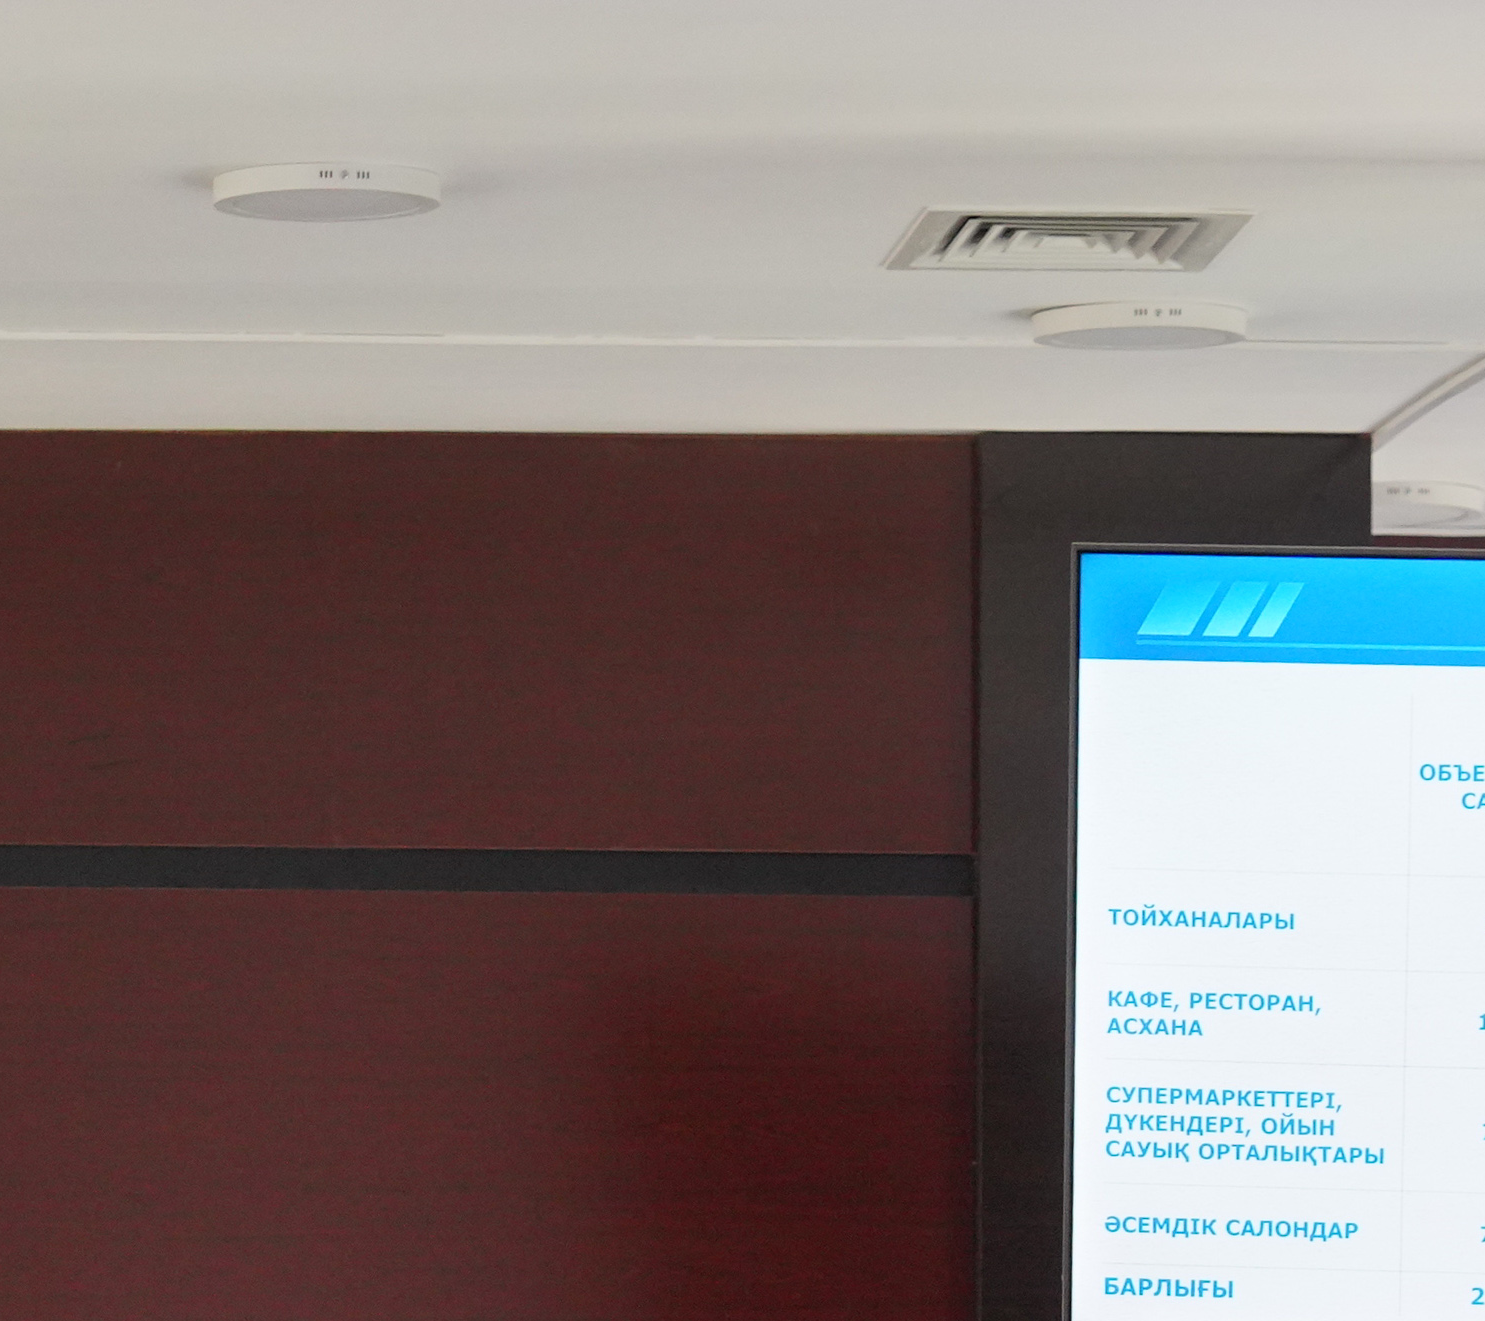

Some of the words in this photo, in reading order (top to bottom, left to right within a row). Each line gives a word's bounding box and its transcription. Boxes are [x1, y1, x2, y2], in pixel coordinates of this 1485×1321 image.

[1107, 904, 1295, 930] ТОЙХАНАЛАРЫ
[1108, 990, 1179, 1013] КАФЕ,
[1189, 992, 1321, 1016] РЕСТОРАН,
[1107, 1017, 1203, 1037] АСХАНА
[1105, 1086, 1344, 1115] СУПЕРМАРКЕТТЕРІ,
[1104, 1112, 1251, 1138] ДҮКЕНДЕРІ,
[1260, 1112, 1336, 1138] ОЙЫН
[1105, 1140, 1190, 1163] САУЫҚ
[1198, 1142, 1385, 1167] ОРТАЛЫҚТАРЫ
[1104, 1214, 1217, 1239] ӘСЕМДІК
[1225, 1217, 1359, 1244] САЛОНДАР
[1104, 1276, 1234, 1299] БАРЛЫҒЫ
